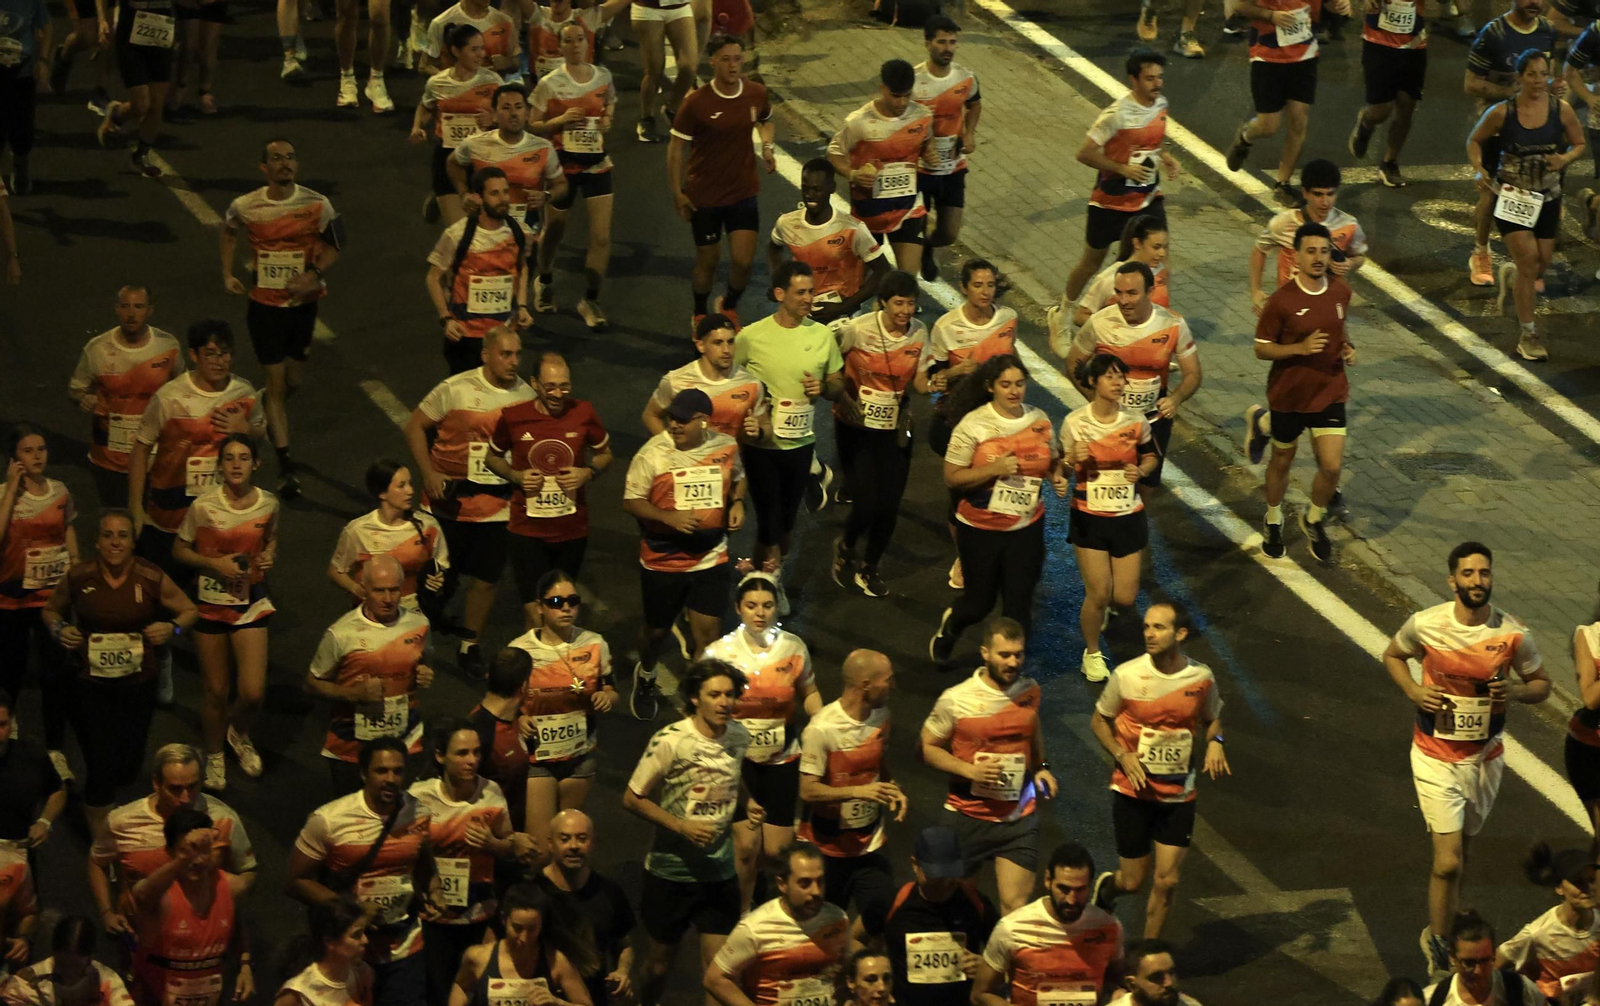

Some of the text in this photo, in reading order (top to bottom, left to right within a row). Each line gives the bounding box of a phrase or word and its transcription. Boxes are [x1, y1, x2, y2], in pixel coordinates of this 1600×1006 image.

[136, 25, 169, 41] 22872
[878, 175, 910, 188] 15868
[1503, 199, 1535, 217] 10520
[263, 265, 299, 278] 18776
[475, 291, 507, 303] 18794
[861, 403, 893, 419] 15852
[684, 484, 713, 498] 7371
[1094, 486, 1129, 500] 17062
[536, 493, 567, 506] 4480
[100, 651, 132, 666] 5062
[1442, 715, 1483, 729] 11304
[541, 723, 581, 741] 19249
[1148, 748, 1181, 763] 5165
[914, 953, 959, 969] 24804
